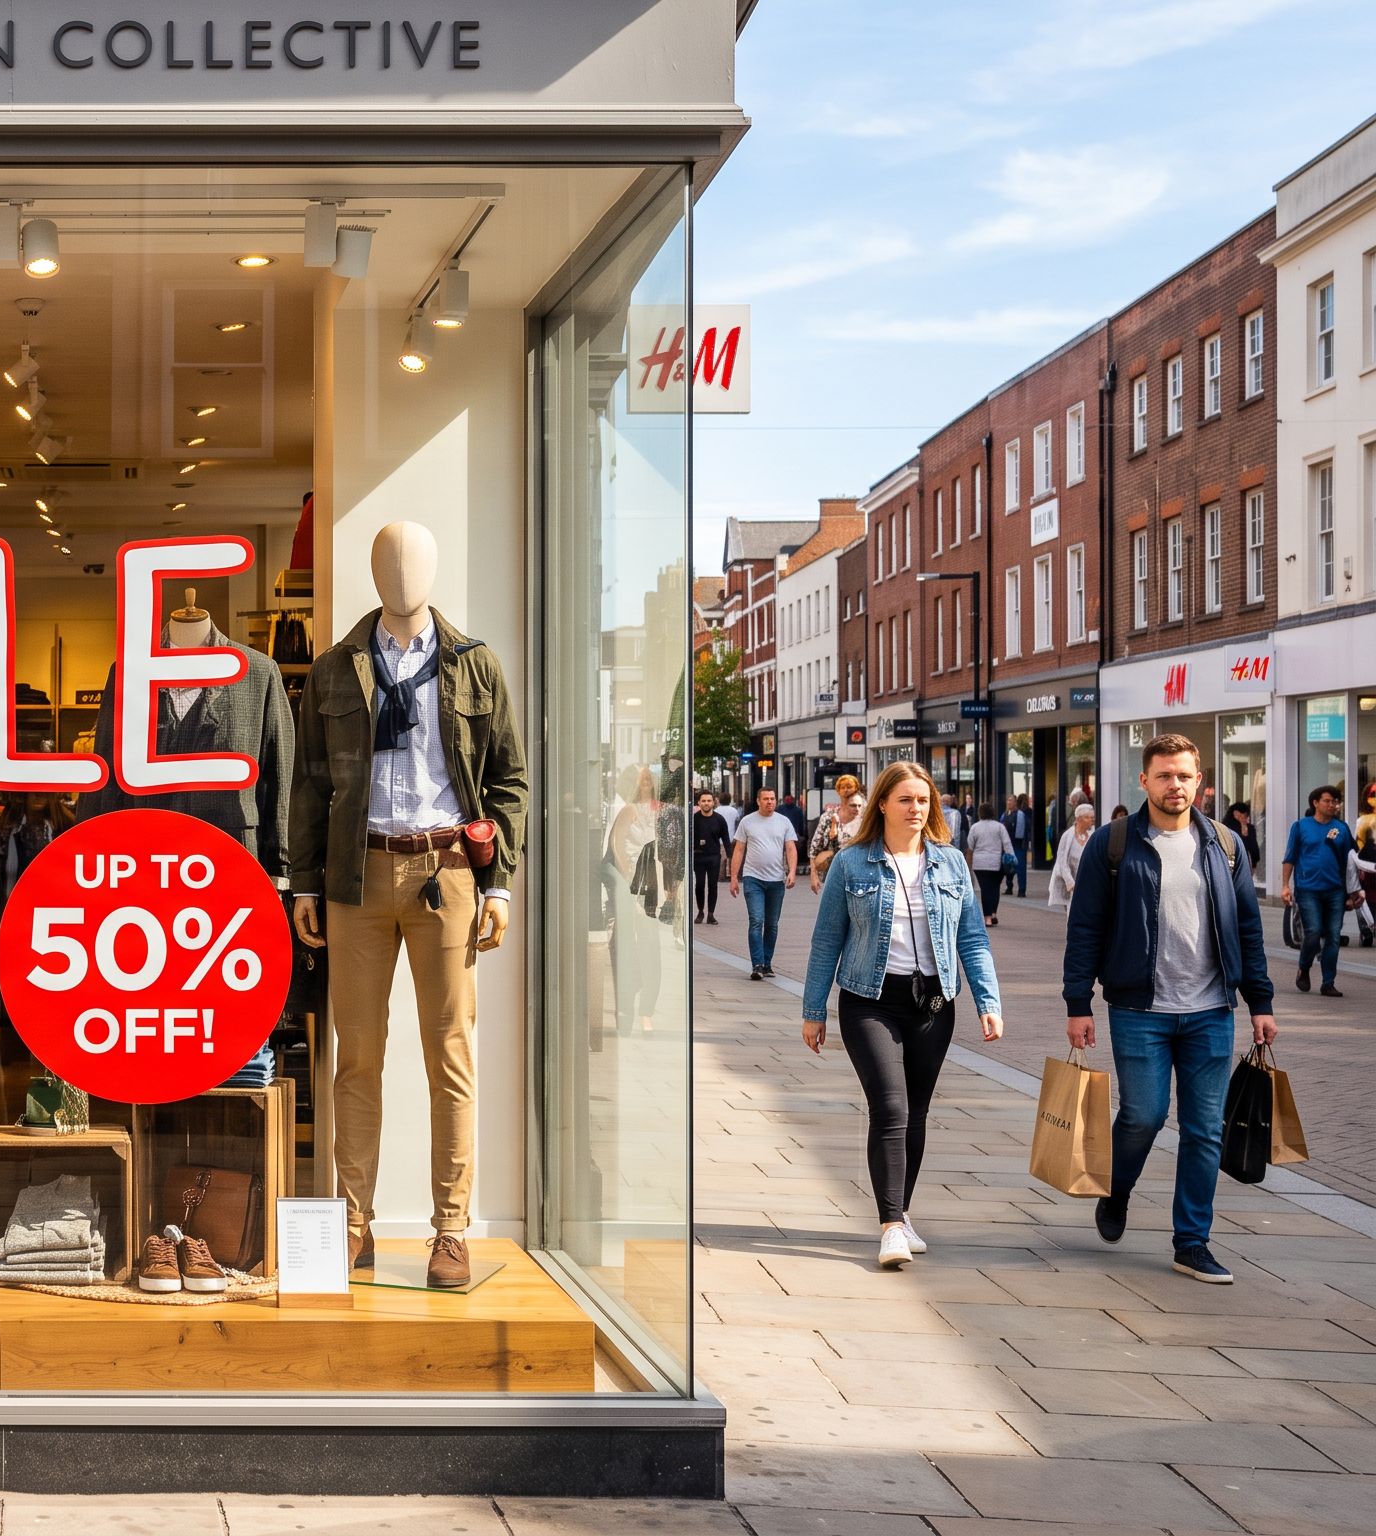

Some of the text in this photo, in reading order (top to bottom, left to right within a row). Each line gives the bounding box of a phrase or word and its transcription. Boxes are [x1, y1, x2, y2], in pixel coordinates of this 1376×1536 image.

[51, 19, 481, 71] COLLECTIVE
[75, 854, 215, 889] UP TO
[26, 906, 263, 992] 50%
[73, 1007, 215, 1054] OFF!
